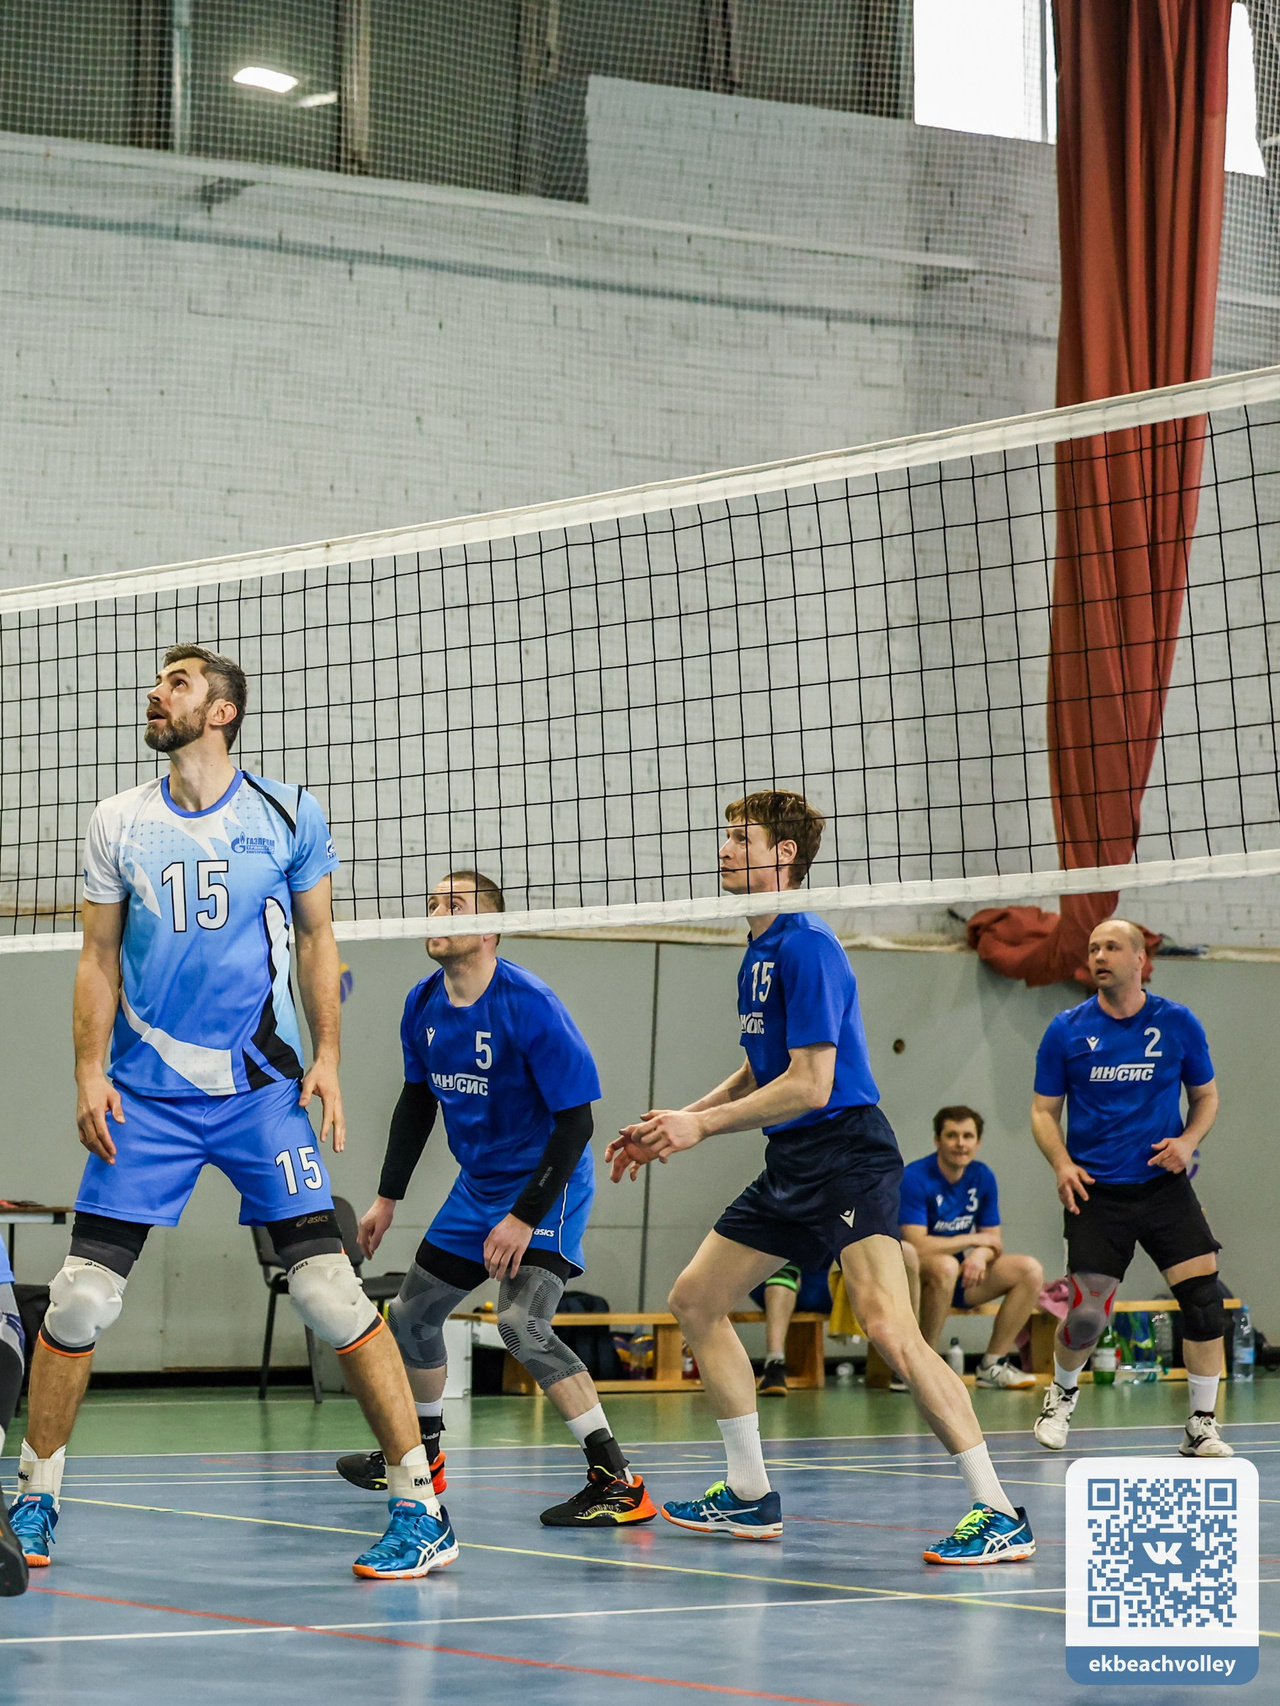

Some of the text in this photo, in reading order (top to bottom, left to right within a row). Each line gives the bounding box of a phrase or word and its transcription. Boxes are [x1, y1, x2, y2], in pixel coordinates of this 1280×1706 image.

[161, 860, 230, 933] 15
[751, 961, 776, 1003] 15
[475, 1030, 493, 1070] 5
[1143, 1026, 1163, 1058] 2
[431, 1072, 489, 1097] ИНСИС
[1089, 1063, 1156, 1082] ИНСИС
[274, 1144, 324, 1197] 15
[965, 1187, 979, 1213] 3
